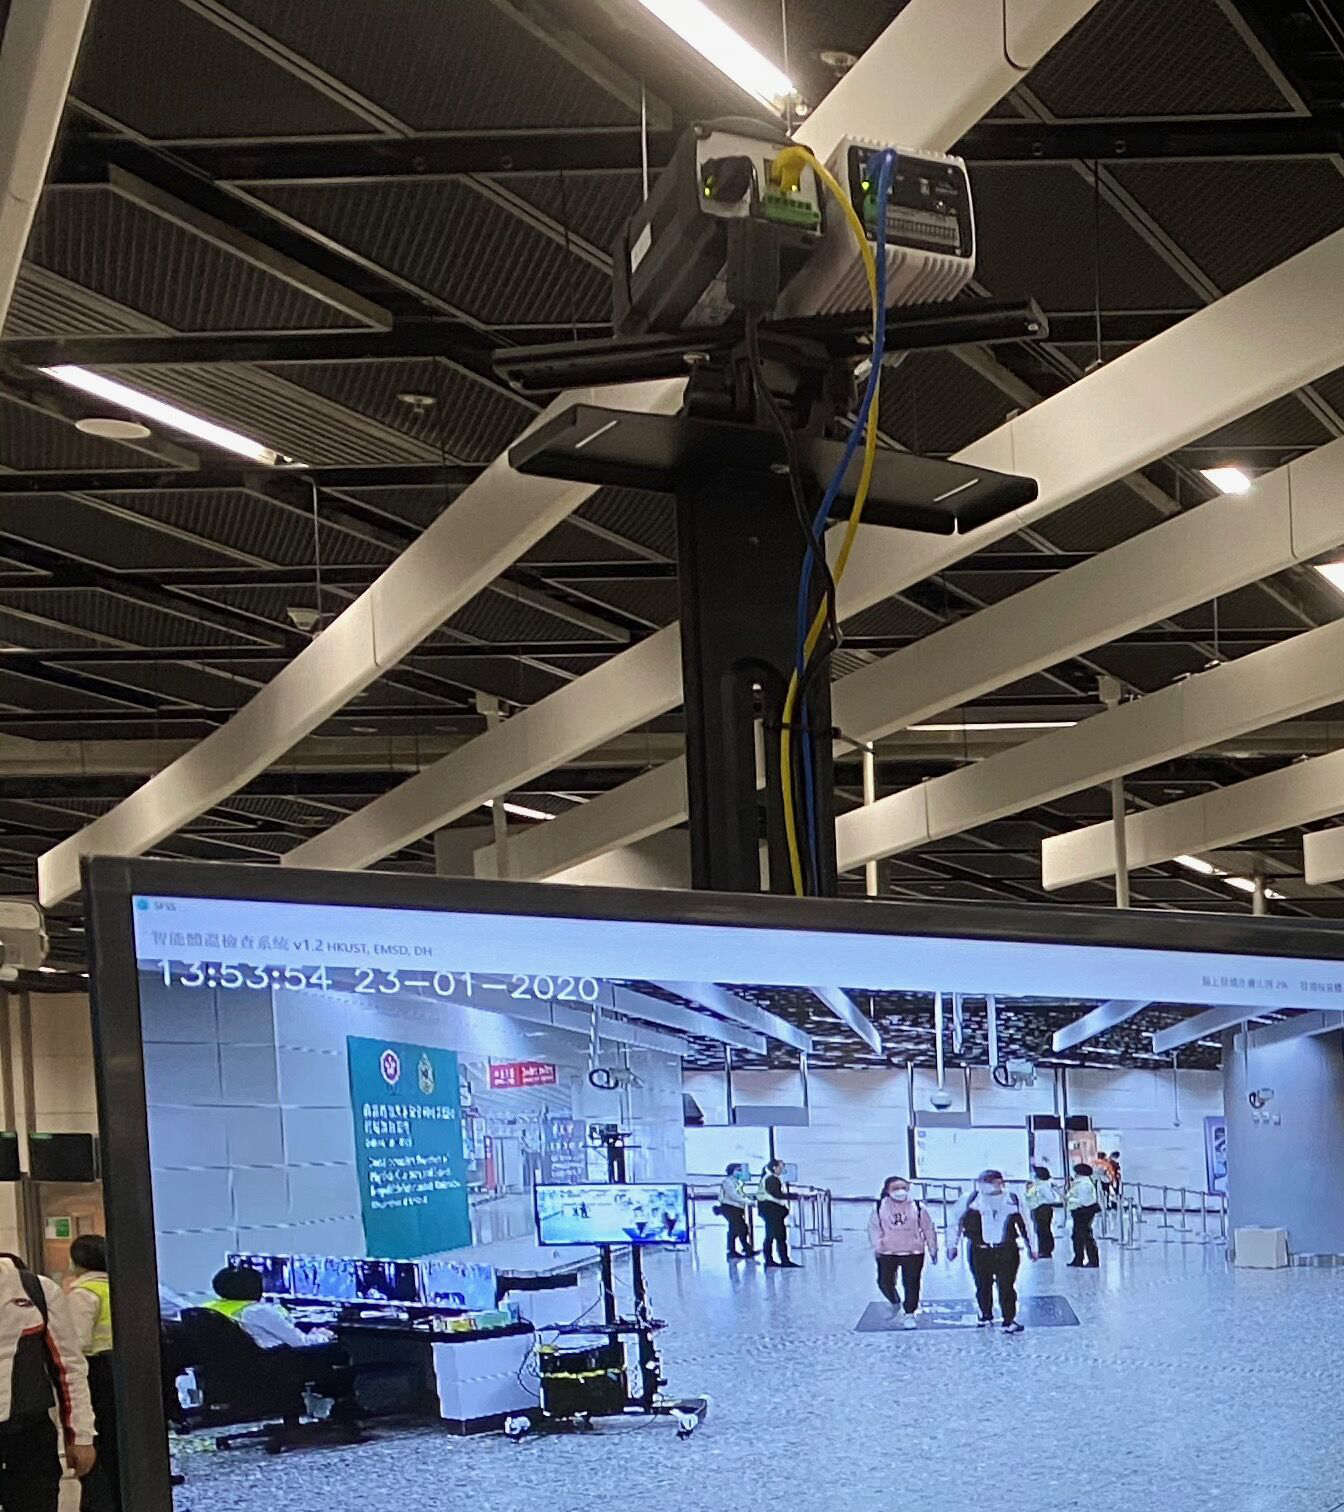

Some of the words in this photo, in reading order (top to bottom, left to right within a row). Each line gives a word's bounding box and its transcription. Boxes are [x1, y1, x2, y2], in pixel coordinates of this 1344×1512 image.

[293, 939, 324, 952] v1.2
[414, 945, 433, 957] DH
[156, 958, 333, 992] 13:53:54
[354, 966, 600, 1003] 23-01-2020
